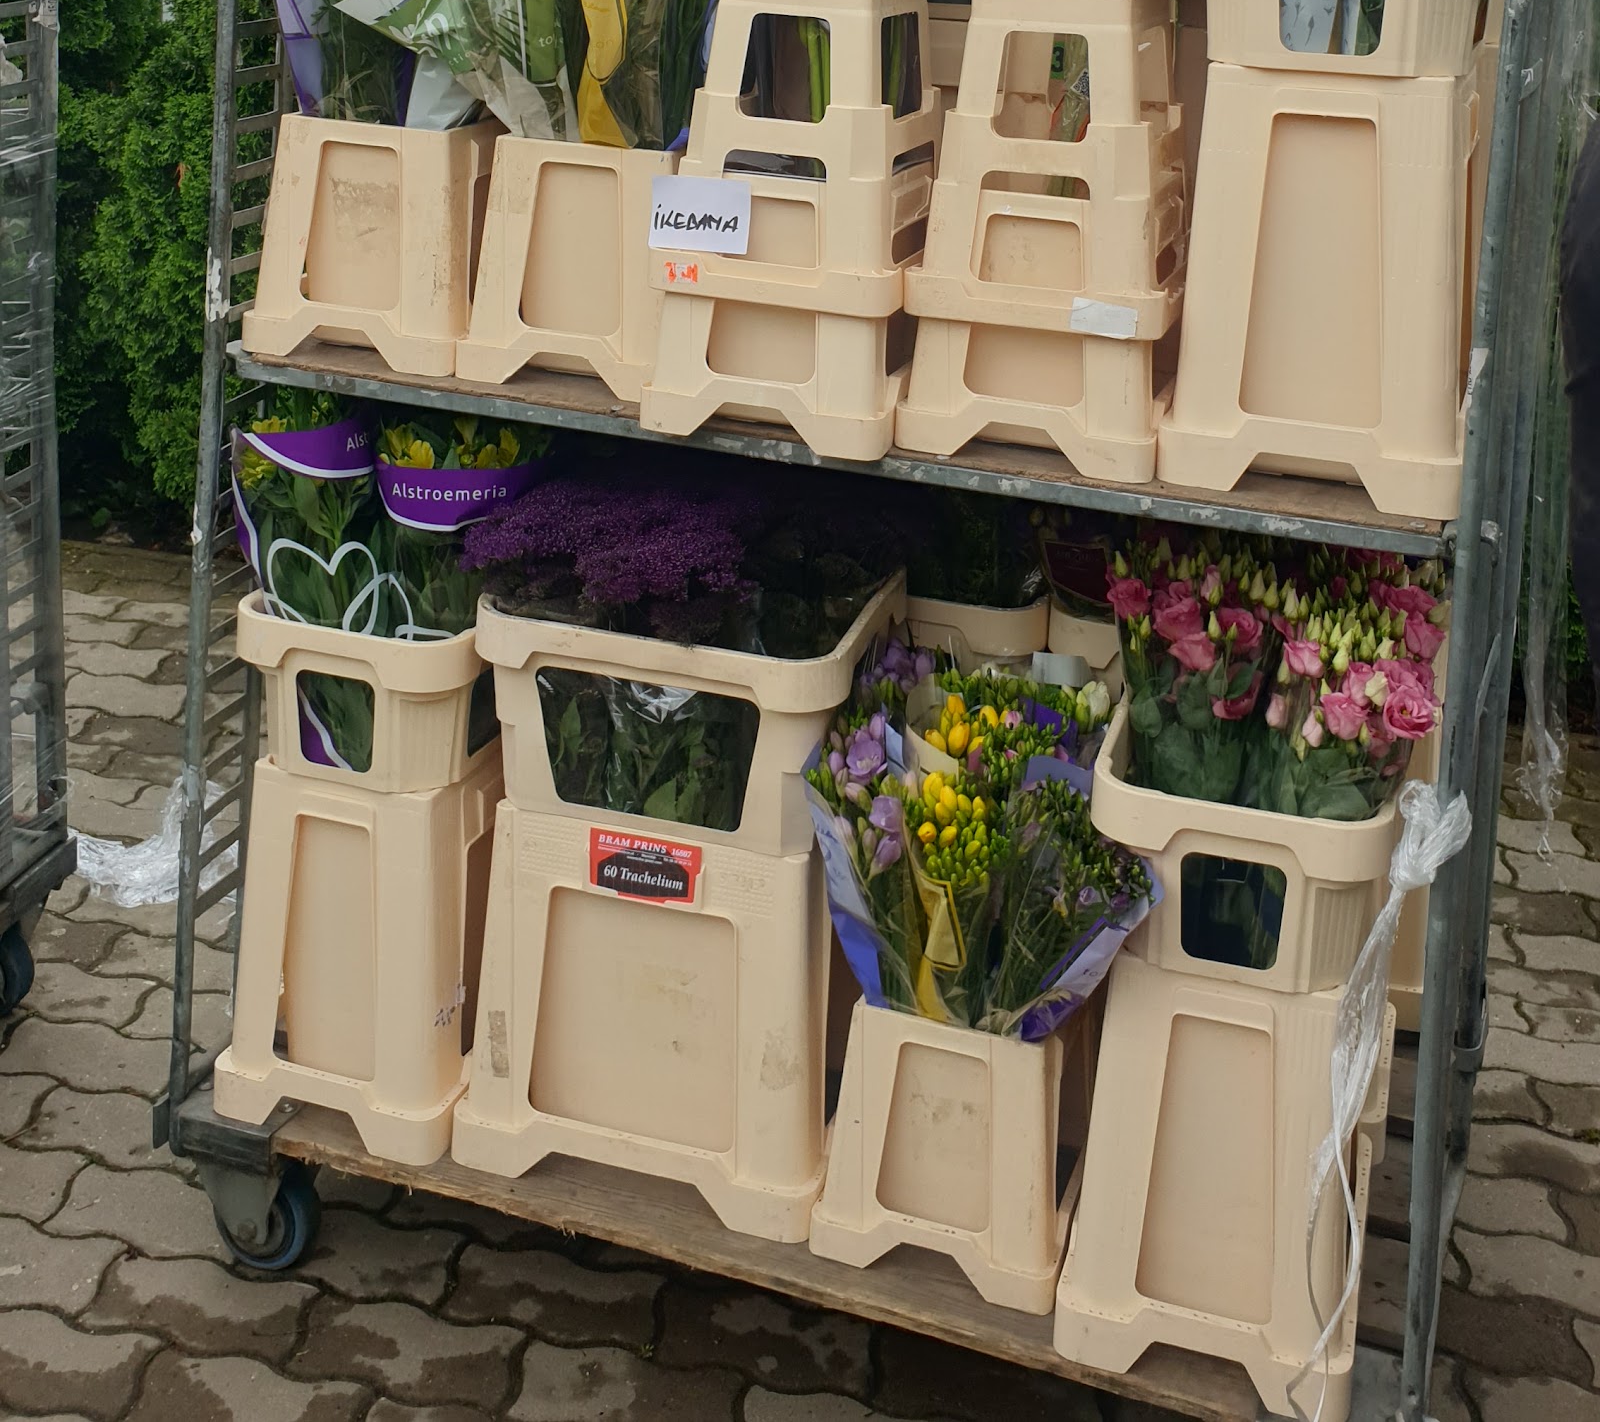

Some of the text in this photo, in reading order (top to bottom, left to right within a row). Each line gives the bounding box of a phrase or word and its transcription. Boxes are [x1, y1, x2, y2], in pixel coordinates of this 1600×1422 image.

[392, 482, 507, 501] Alstroemeria
[599, 834, 630, 847] BRAM
[633, 840, 667, 853] PRINS
[604, 865, 683, 890] 60 Trachelium
